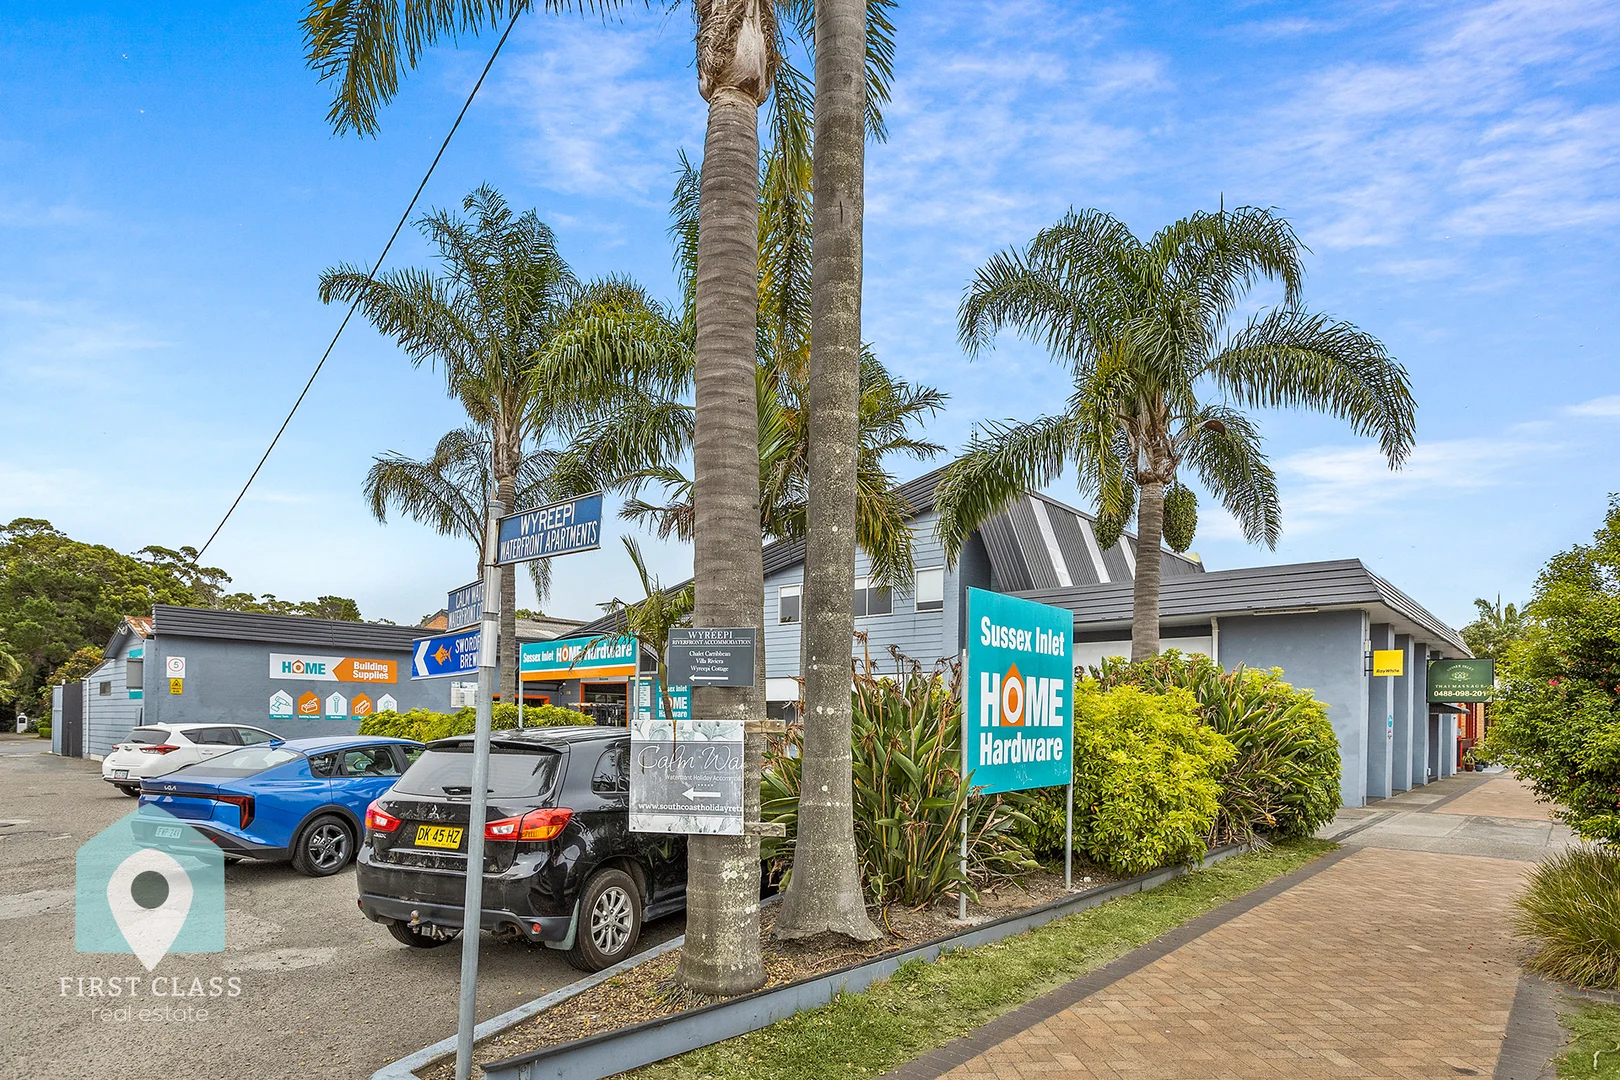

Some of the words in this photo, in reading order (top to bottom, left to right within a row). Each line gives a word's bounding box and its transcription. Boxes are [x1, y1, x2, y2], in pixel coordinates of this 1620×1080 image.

[520, 502, 576, 536] WYREEPI
[500, 532, 545, 561] WATERFRONT
[544, 520, 598, 553] APARTMENTS
[455, 587, 472, 609] CALM
[688, 631, 733, 639] WYREEPI
[980, 615, 1032, 652] Sussex
[1035, 626, 1065, 657] Inlet
[523, 652, 541, 663] Sussex
[541, 650, 554, 662] Inlet
[173, 661, 180, 669] 5
[282, 660, 326, 675] HOME
[353, 661, 388, 672] Building
[353, 670, 389, 680] Supplies
[980, 669, 1064, 727] HOME
[658, 709, 688, 718] Haware
[979, 731, 1063, 766] Hardware
[637, 744, 695, 772] Calm
[693, 774, 712, 783] Holiday
[417, 827, 432, 841] DK
[432, 828, 446, 842] 45
[446, 829, 460, 844] HZ
